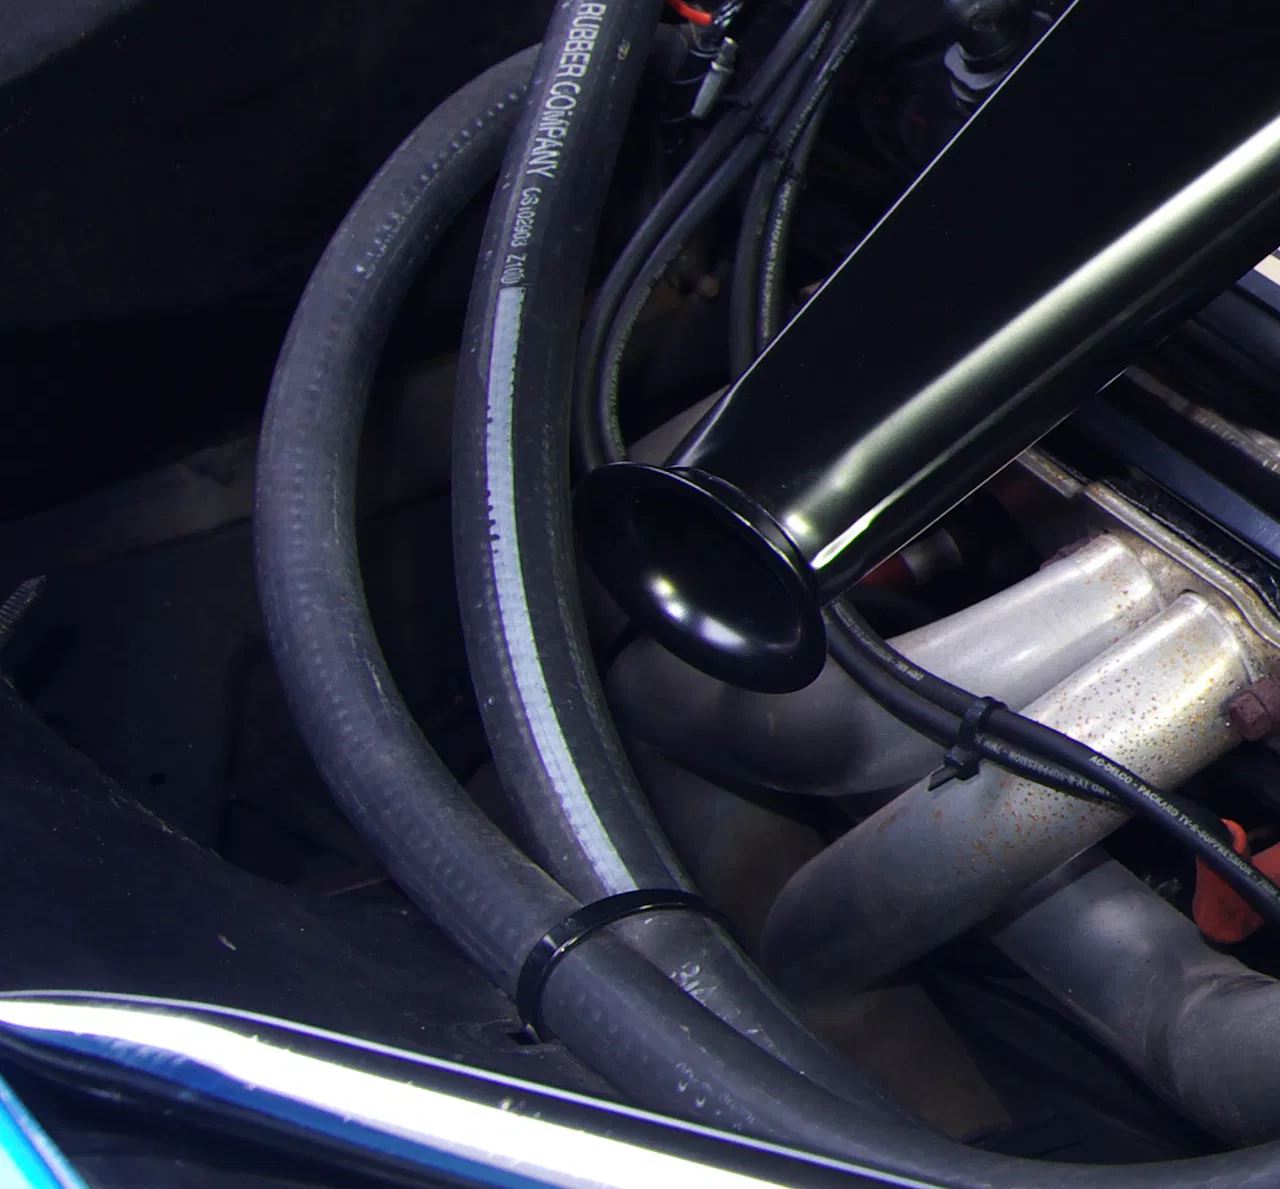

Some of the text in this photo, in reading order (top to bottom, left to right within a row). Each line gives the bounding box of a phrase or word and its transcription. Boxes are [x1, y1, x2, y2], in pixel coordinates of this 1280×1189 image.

[555, 2, 607, 79] RUBBER
[527, 81, 582, 179] COMPANY
[1089, 755, 1133, 785] AC-DELCO
[1137, 785, 1179, 817] PACKARD
